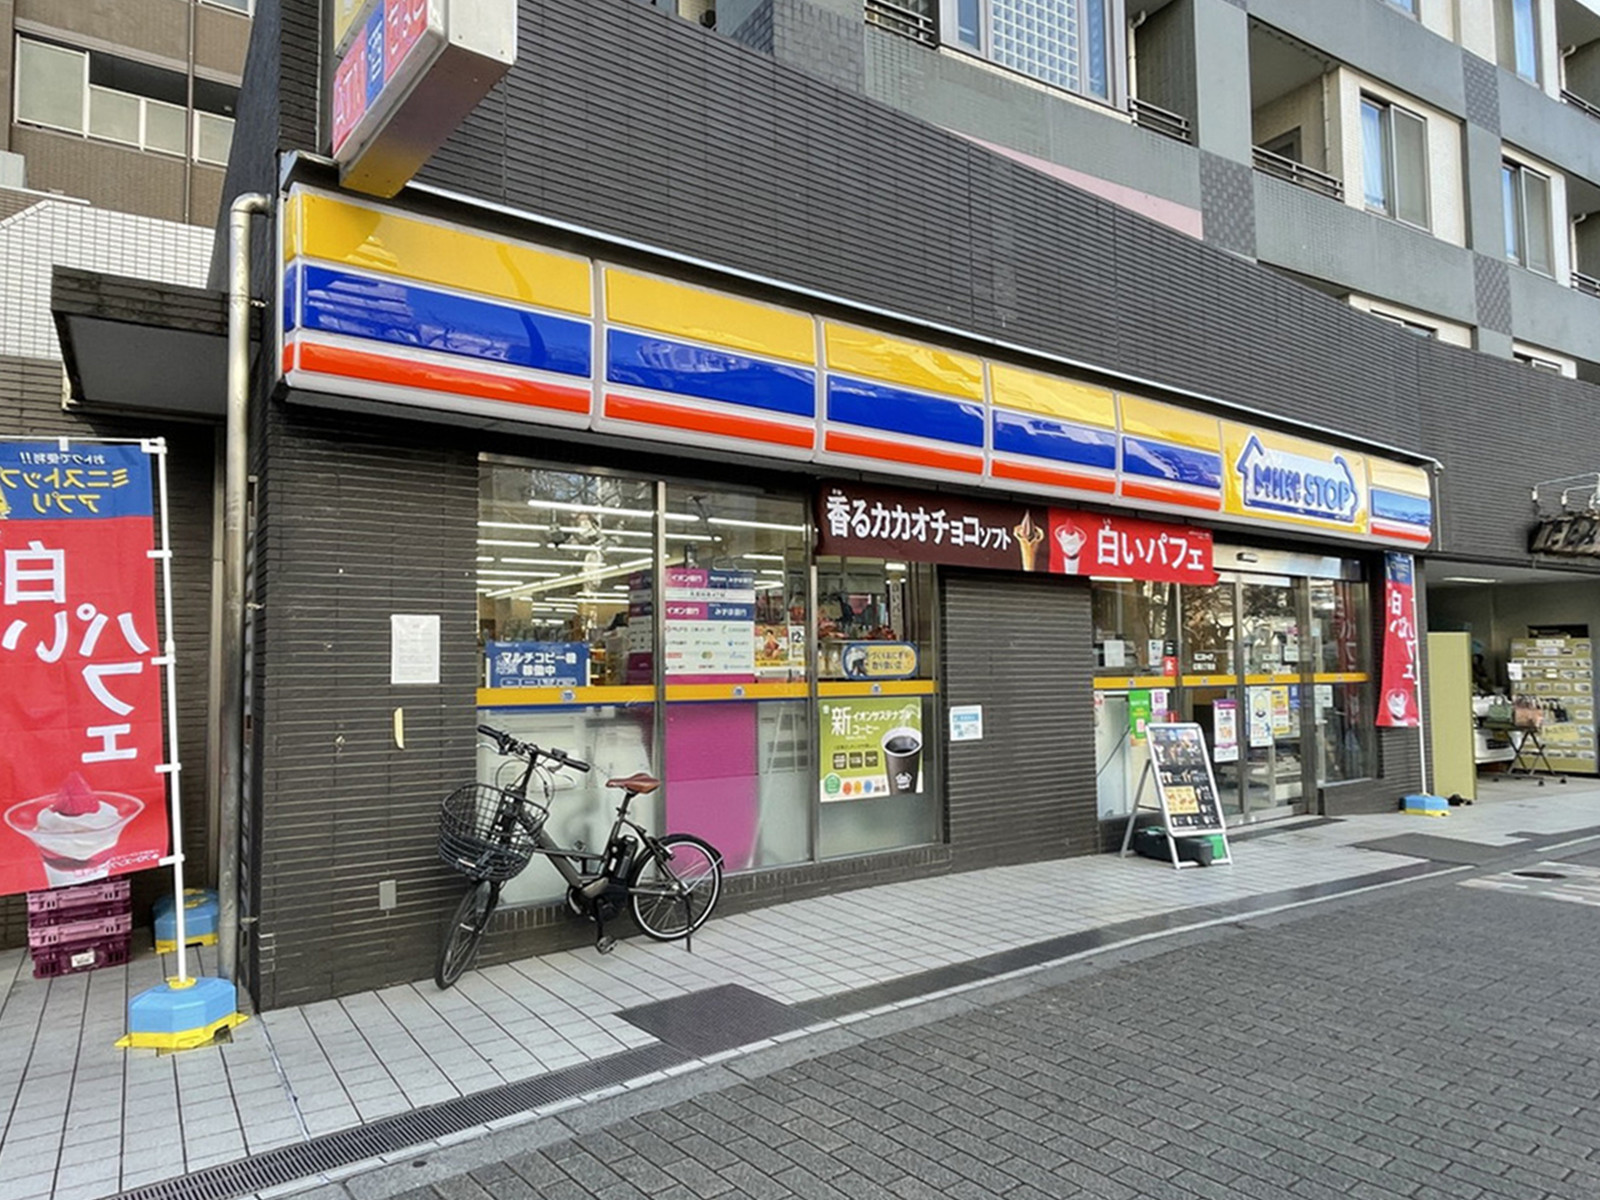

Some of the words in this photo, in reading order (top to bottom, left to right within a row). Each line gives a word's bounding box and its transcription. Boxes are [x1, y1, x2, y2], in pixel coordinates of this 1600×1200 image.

[1304, 473, 1352, 511] STOP
[826, 495, 1012, 551] 香るカカオチョコソフト
[1097, 524, 1204, 571] 白いパフェ
[831, 706, 852, 736] 新
